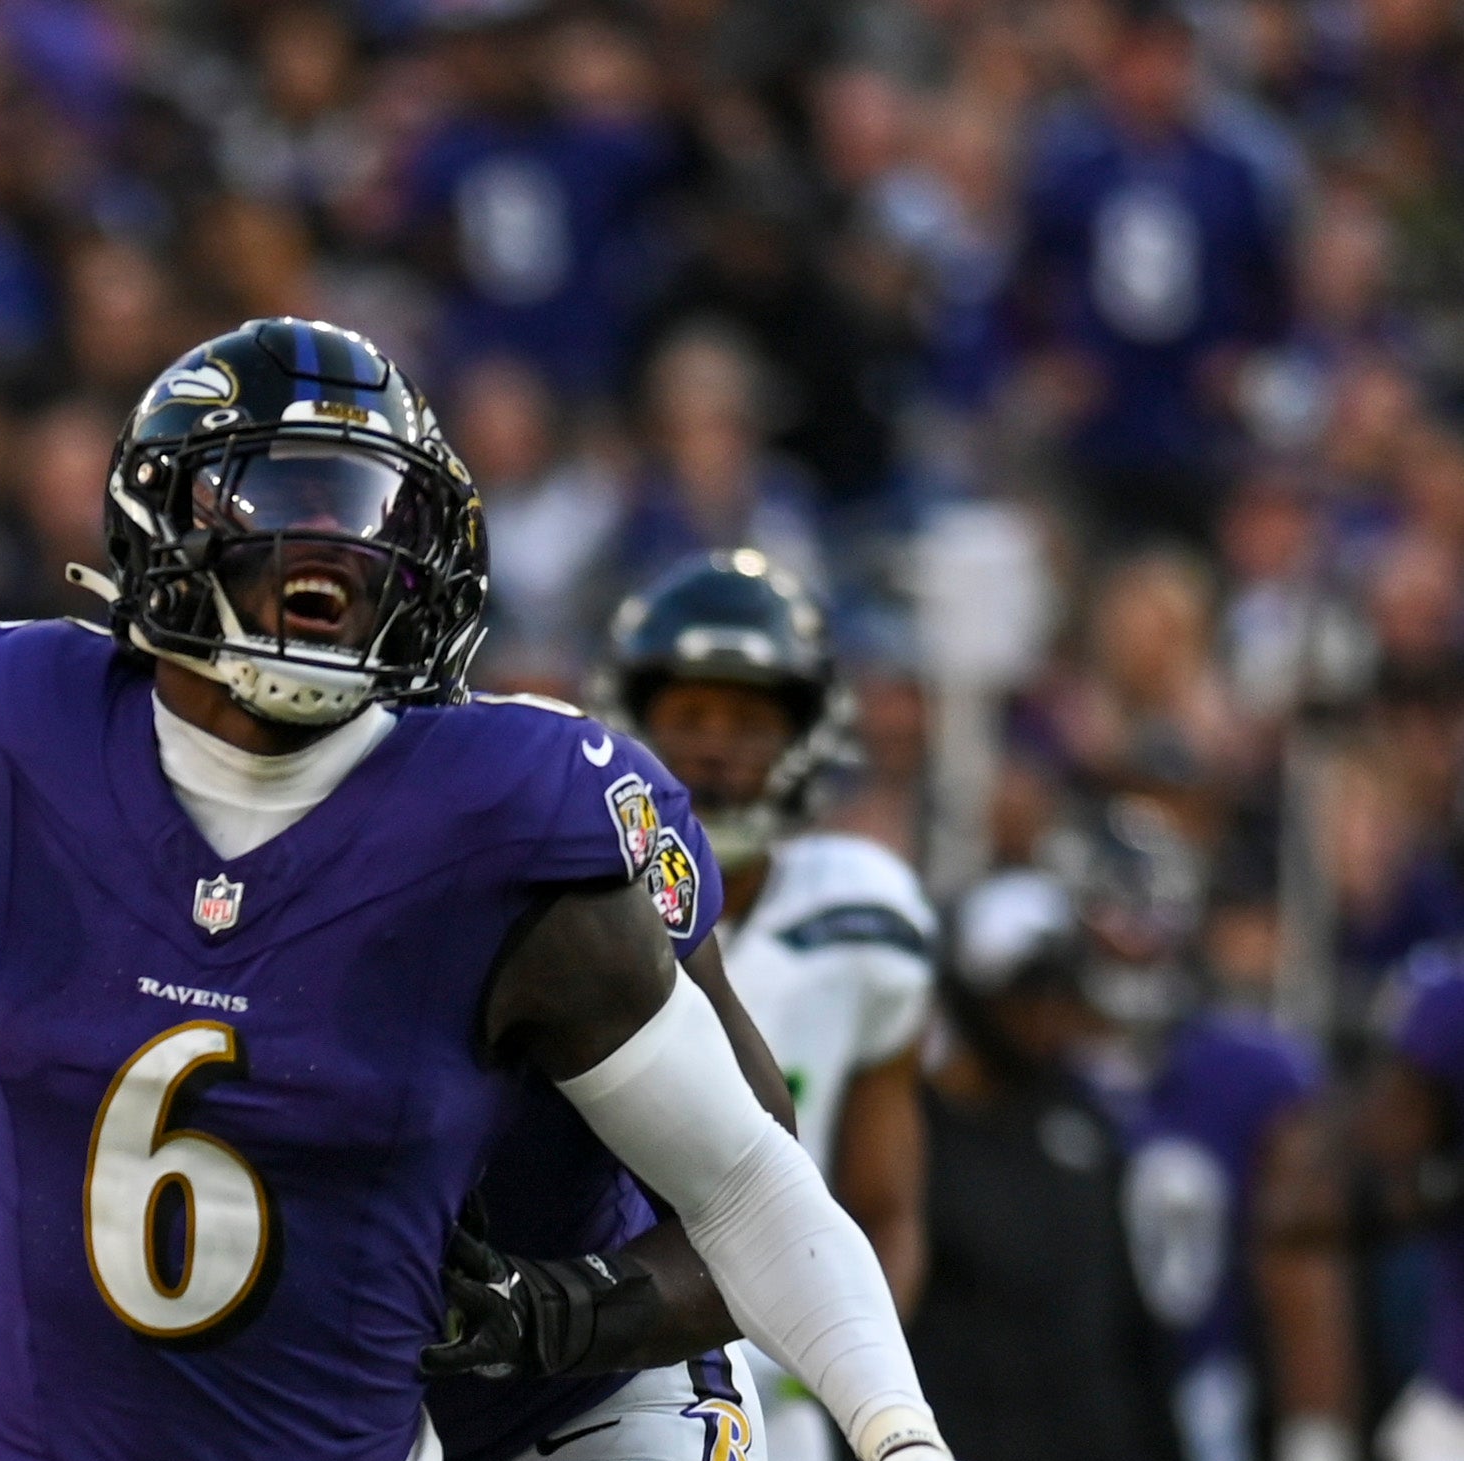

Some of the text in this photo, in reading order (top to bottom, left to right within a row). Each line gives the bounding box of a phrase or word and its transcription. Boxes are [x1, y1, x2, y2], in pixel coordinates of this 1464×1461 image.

[202, 899, 231, 919] NFL
[137, 976, 249, 1013] RAVENS
[83, 1019, 269, 1338] 6
